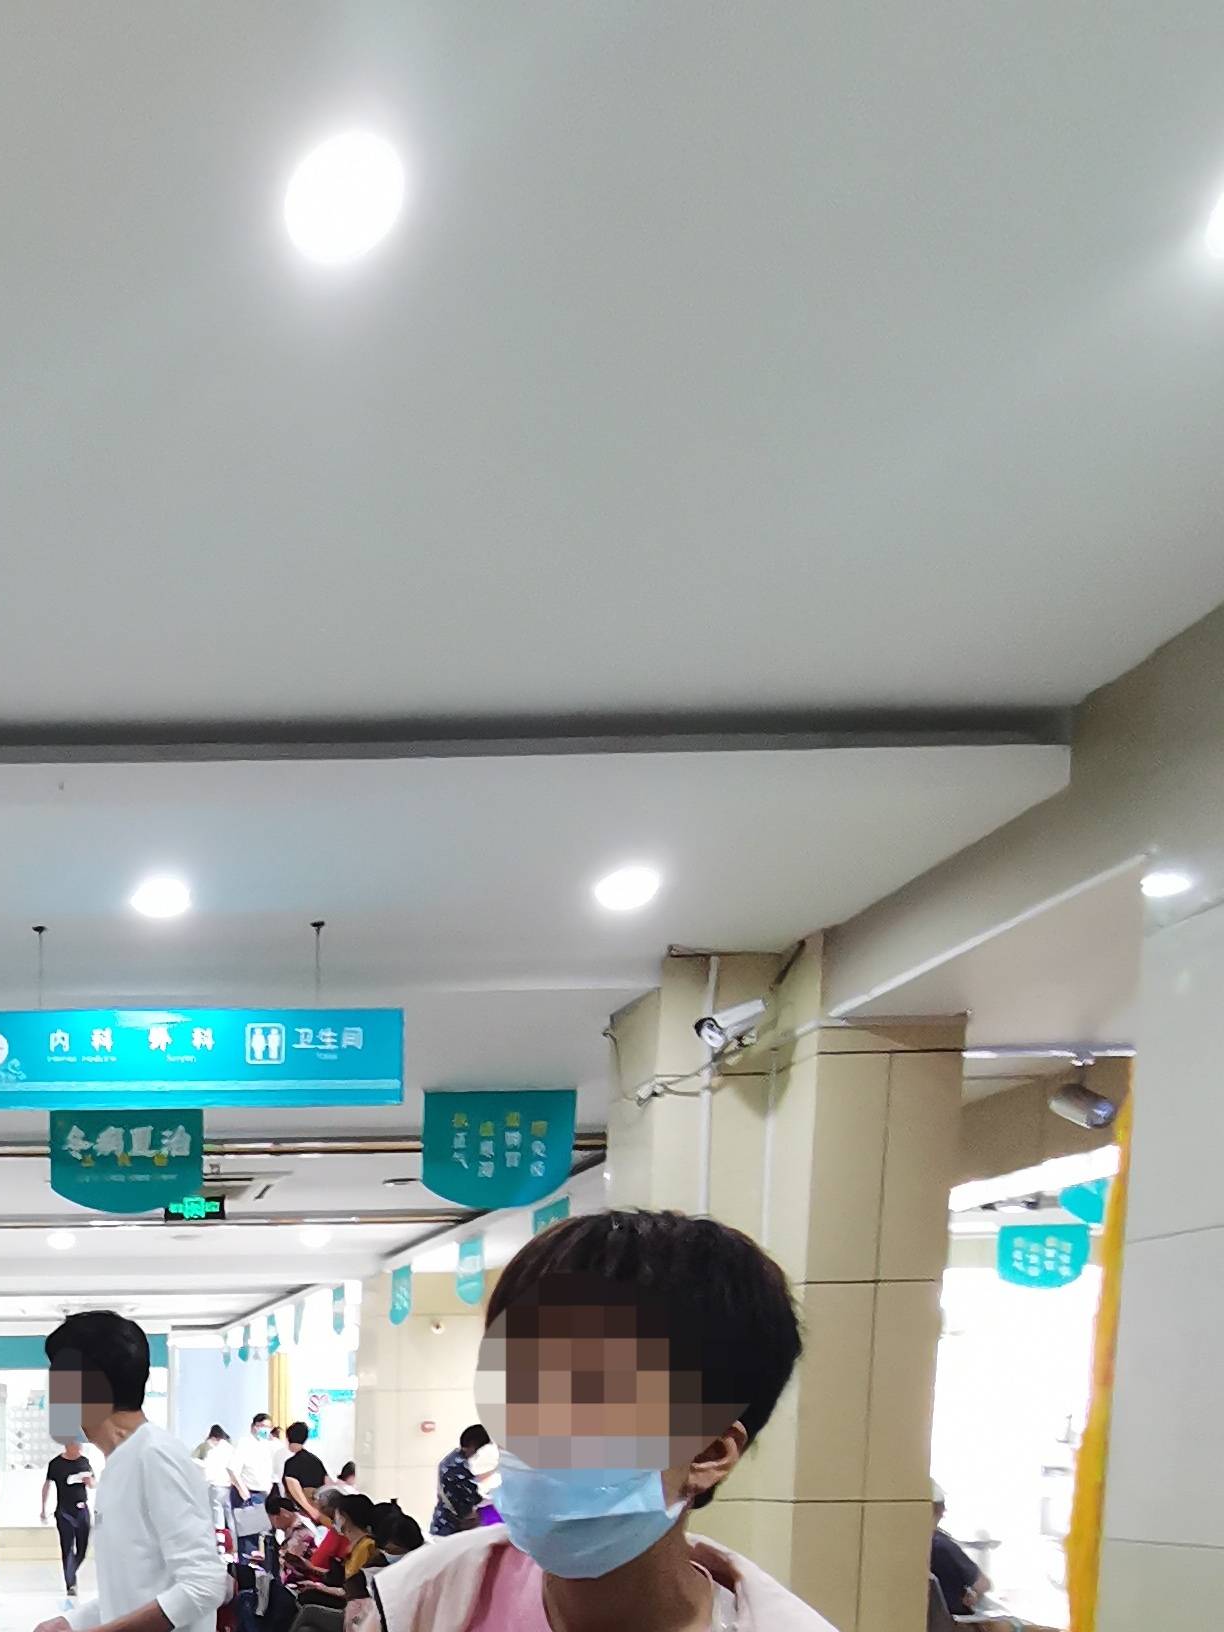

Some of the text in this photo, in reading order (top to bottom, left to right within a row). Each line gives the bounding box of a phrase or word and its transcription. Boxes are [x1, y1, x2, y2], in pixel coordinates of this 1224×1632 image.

[49, 1028, 113, 1052] 内科
[292, 1027, 364, 1050] 卫生间
